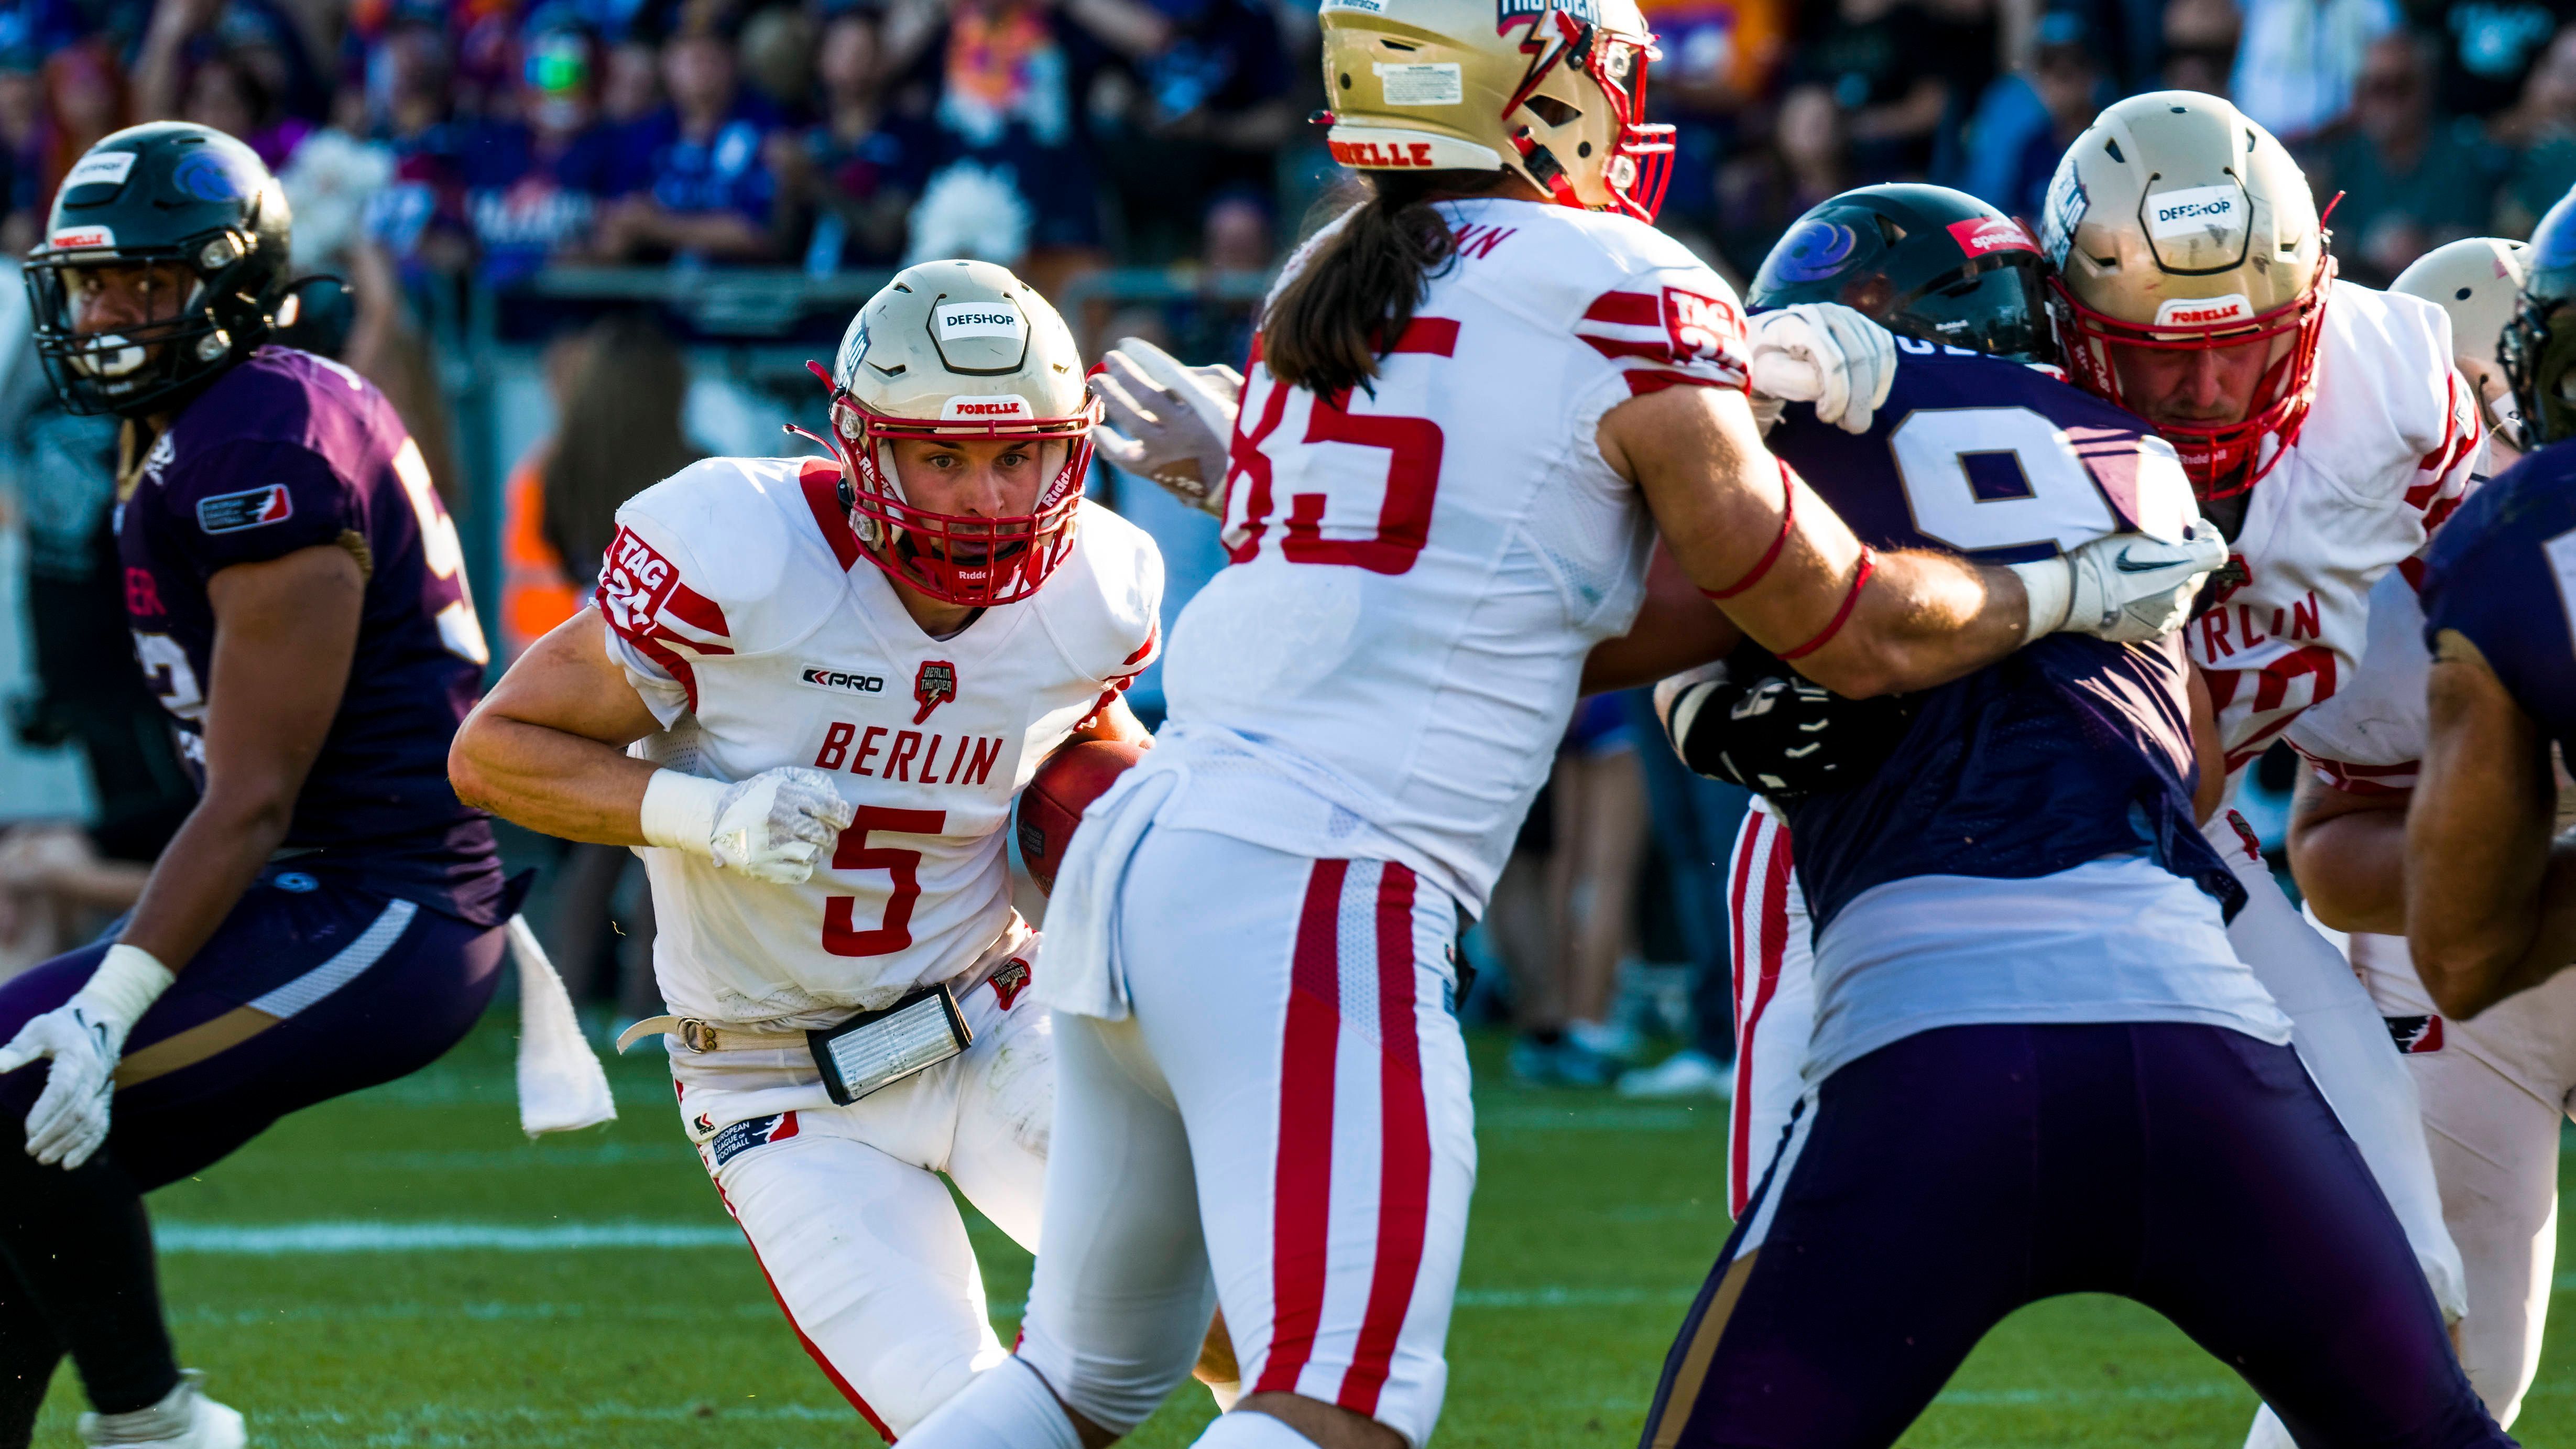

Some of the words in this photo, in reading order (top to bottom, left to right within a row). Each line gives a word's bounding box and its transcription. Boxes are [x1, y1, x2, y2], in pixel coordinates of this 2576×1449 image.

[947, 314, 1014, 326] DEFSHOP
[956, 403, 1020, 414] FORELLE
[619, 533, 668, 591] TAG
[2201, 591, 2320, 664] RLIN
[814, 722, 1003, 785] BERLIN
[822, 804, 946, 957] 5
[713, 1121, 750, 1146] EUROPEAN
[716, 1134, 738, 1153] LEAGUE
[717, 1137, 750, 1162] FOOTBALL
